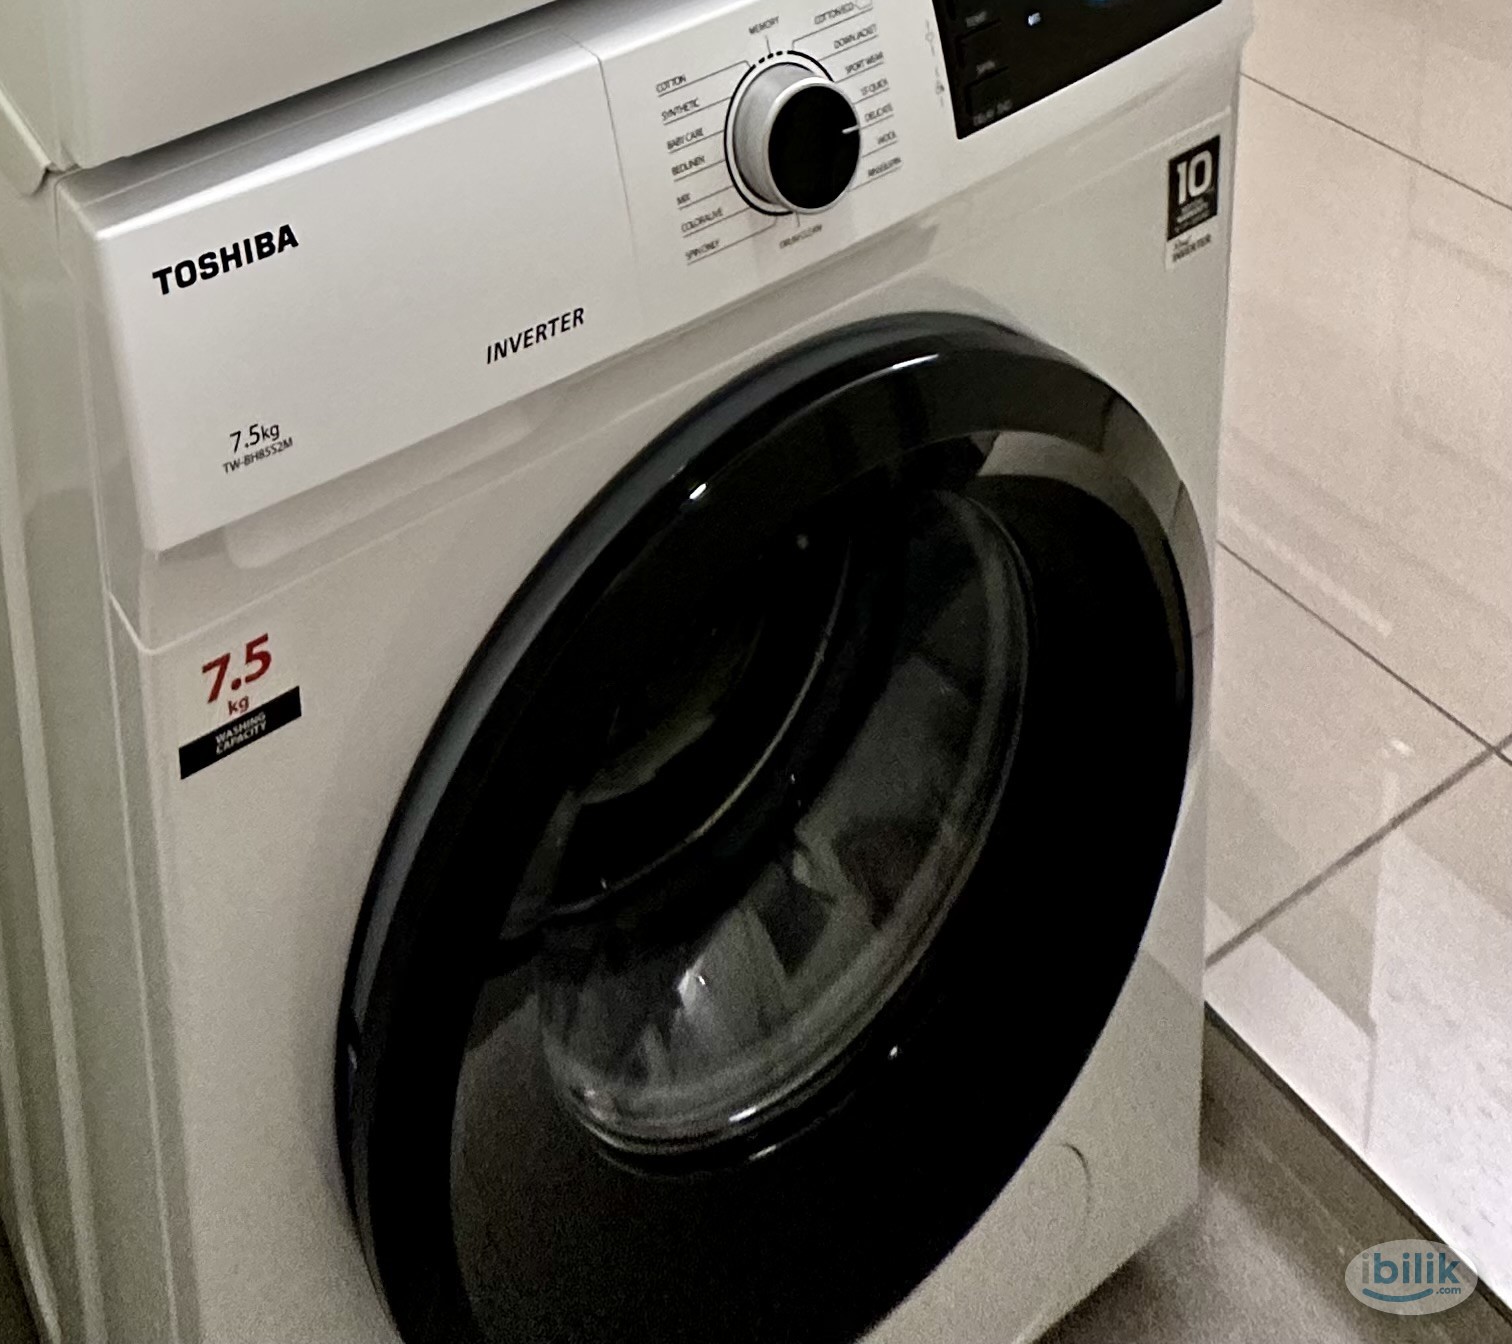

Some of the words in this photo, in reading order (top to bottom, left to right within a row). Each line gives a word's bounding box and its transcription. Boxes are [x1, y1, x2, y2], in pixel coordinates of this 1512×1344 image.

[748, 16, 779, 34] MEMORY
[656, 74, 686, 93] COTTON
[666, 135, 685, 150] BABY
[685, 127, 704, 142] CARE
[1176, 150, 1213, 205] 10
[152, 223, 299, 295] TOSHIBA
[486, 307, 586, 365] INVERTER
[229, 424, 280, 453] 7.5kg
[202, 632, 272, 704] 7.5
[228, 696, 250, 715] kg
[215, 711, 266, 743] WASHING
[216, 722, 267, 754] CAPACITY
